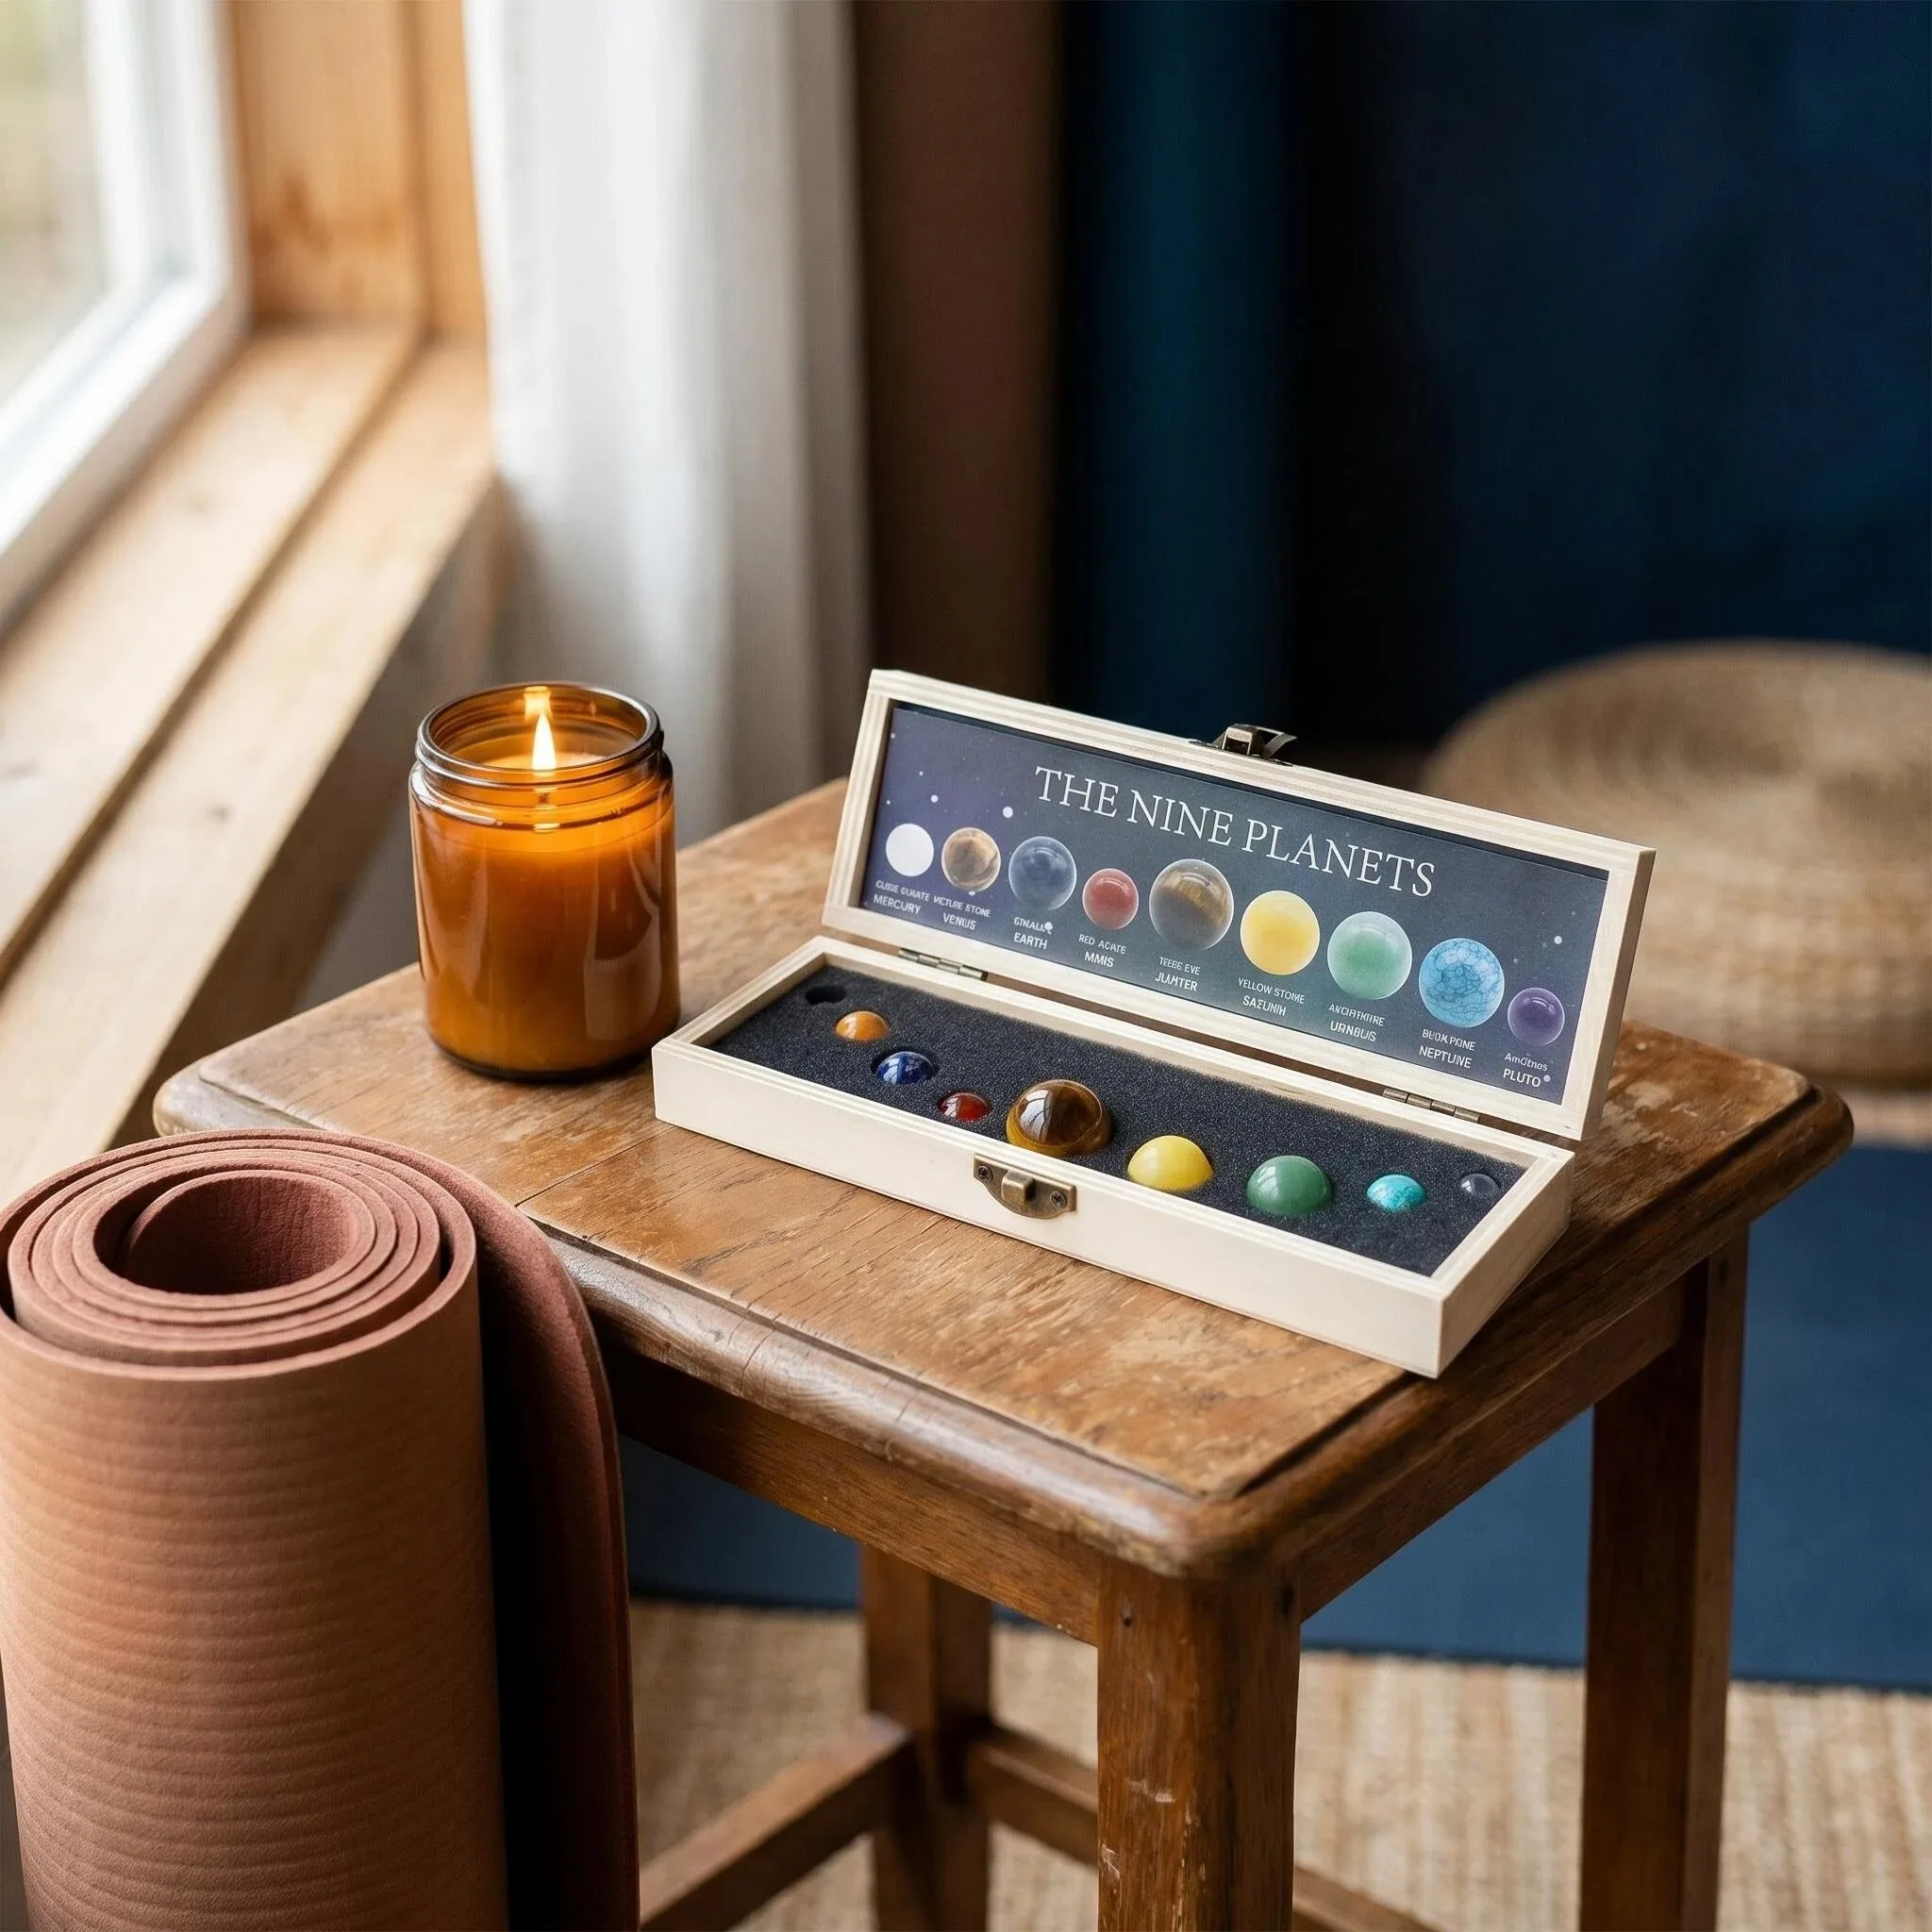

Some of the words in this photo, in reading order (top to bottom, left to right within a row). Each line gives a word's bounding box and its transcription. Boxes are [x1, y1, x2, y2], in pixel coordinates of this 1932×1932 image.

[1035, 766, 1120, 819] THE
[1126, 790, 1234, 847] NINE
[1241, 819, 1436, 898] PLANETS
[873, 894, 922, 914] MERCURY
[942, 912, 977, 930] VENUS
[1013, 932, 1048, 950] EARTH
[1078, 934, 1096, 945] RED
[1238, 977, 1273, 995] YELLOW
[1419, 1045, 1473, 1069] NEPTUNE
[1503, 1068, 1541, 1088] PLUTO
